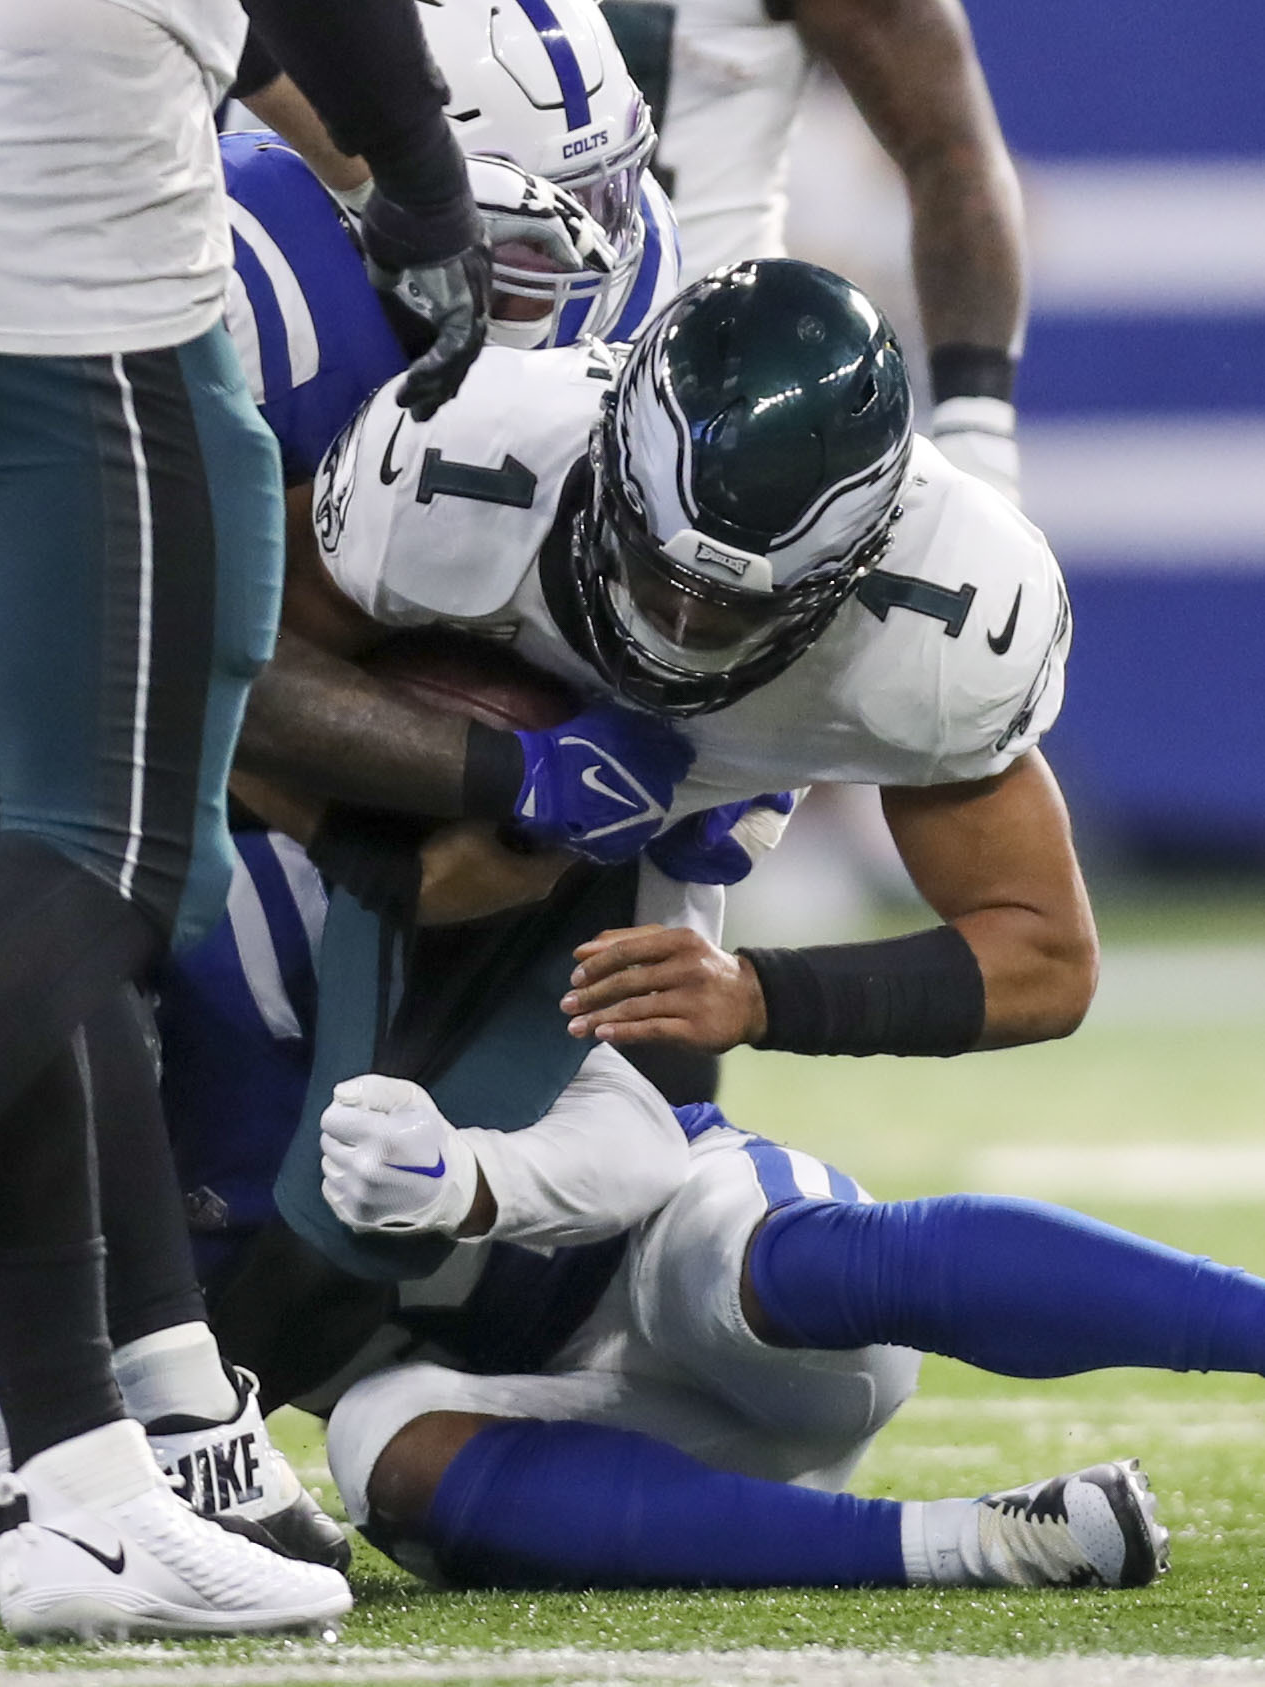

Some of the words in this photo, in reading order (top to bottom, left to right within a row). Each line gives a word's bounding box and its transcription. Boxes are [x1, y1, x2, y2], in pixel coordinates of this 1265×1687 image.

[562, 130, 608, 160] COLTS
[415, 447, 538, 508] 1
[854, 567, 977, 638] 1
